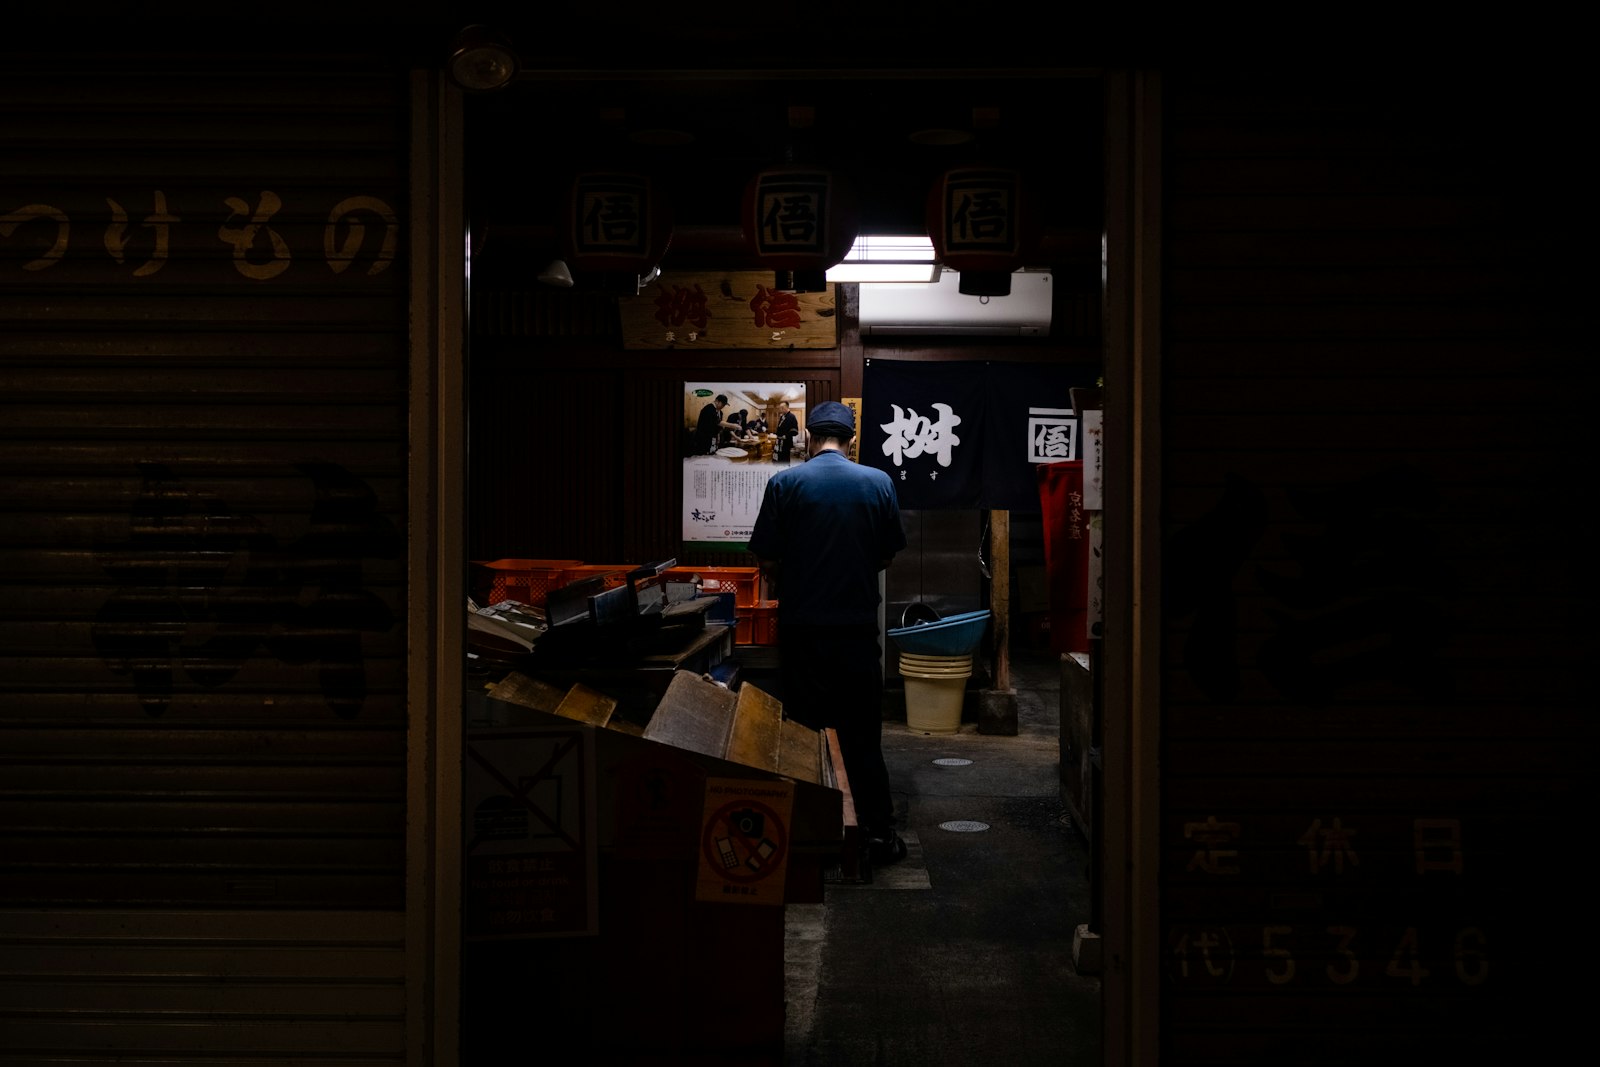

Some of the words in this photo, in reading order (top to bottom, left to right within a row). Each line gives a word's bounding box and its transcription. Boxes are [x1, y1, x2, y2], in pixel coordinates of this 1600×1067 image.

[0, 189, 400, 280] つけもの
[709, 785, 723, 794] NO
[1183, 815, 1465, 877] 定休日
[1262, 923, 1489, 987] 5346
